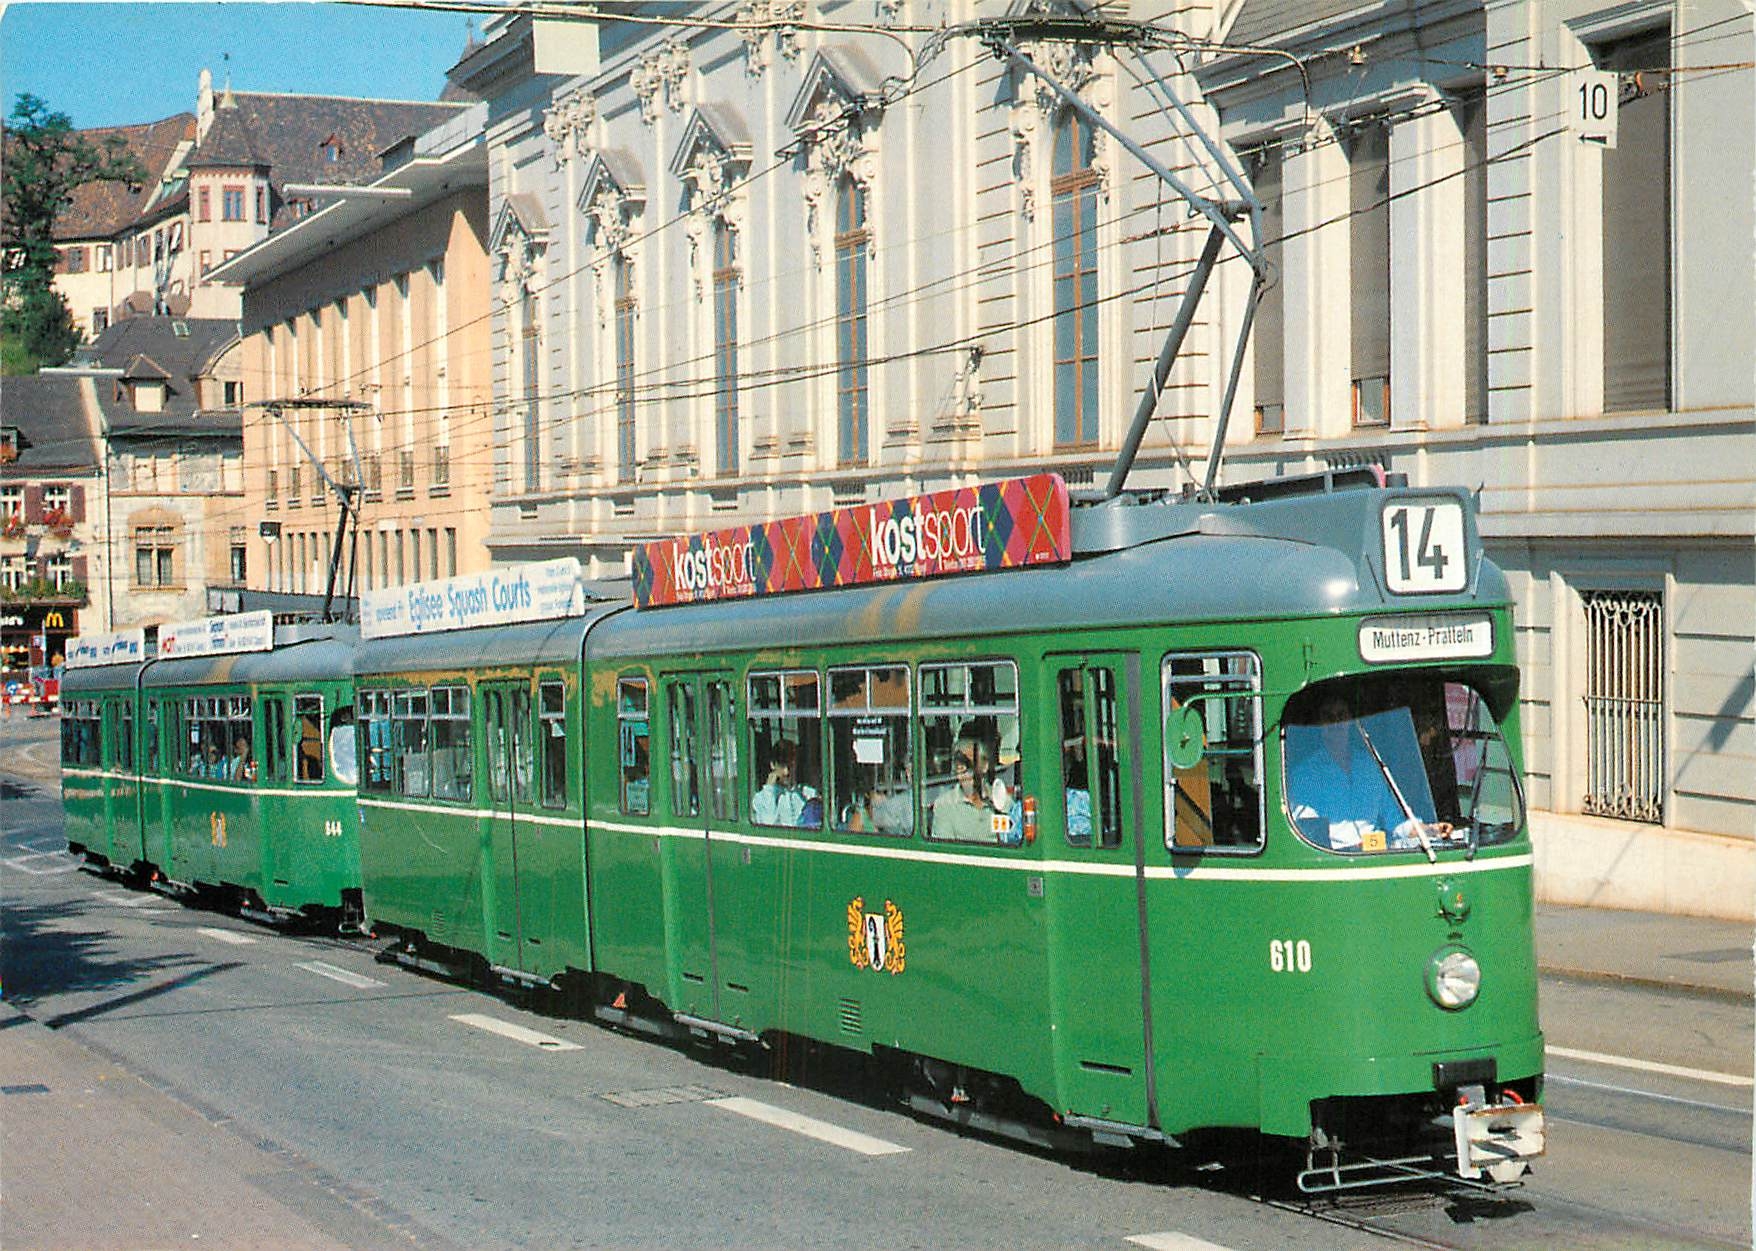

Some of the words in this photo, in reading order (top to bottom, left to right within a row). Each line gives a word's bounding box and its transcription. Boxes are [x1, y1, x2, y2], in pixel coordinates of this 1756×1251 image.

[1579, 83, 1607, 120] 10
[1391, 507, 1449, 581] 14
[447, 577, 489, 625] Squash
[492, 572, 532, 612] Courts
[1270, 939, 1312, 972] 610
